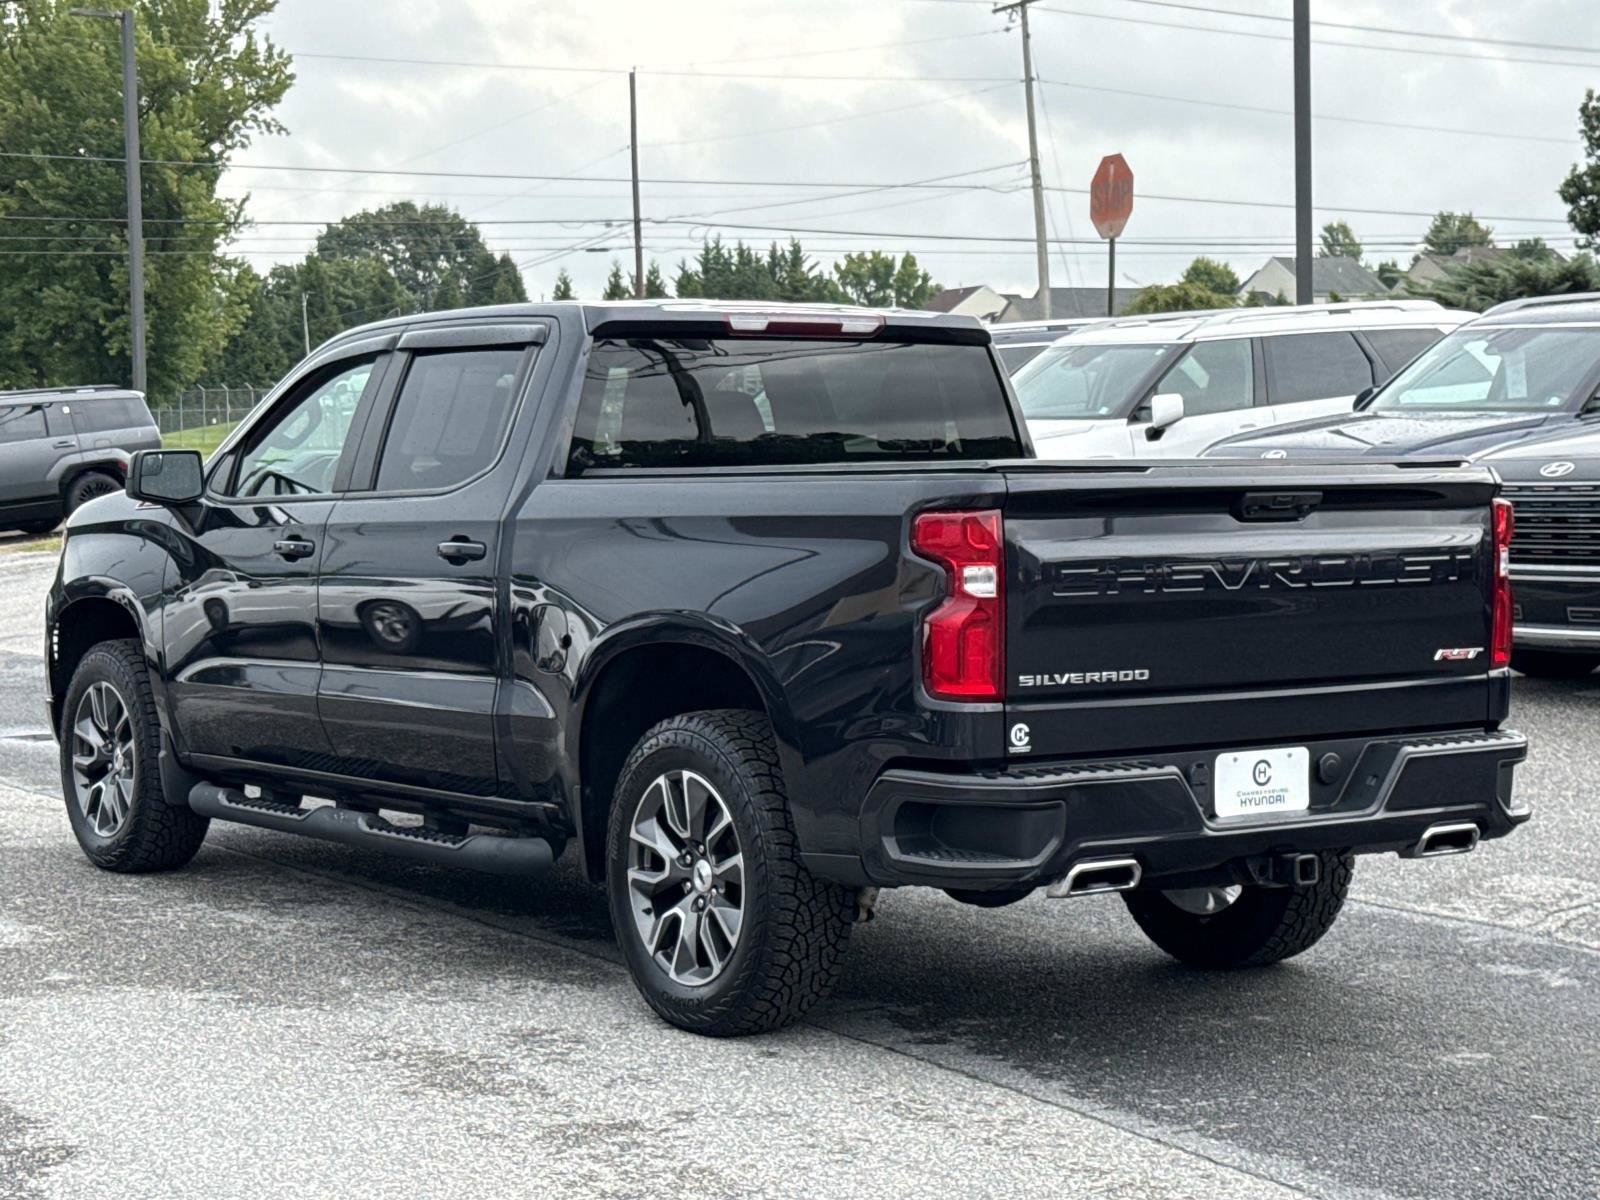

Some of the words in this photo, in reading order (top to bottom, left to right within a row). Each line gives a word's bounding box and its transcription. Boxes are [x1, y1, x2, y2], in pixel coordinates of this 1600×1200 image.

[1053, 554, 1471, 596] CHEVROLET
[1434, 647, 1484, 661] RST
[1018, 669, 1150, 687] SILVERADO
[1240, 794, 1285, 807] HYUNDAI
